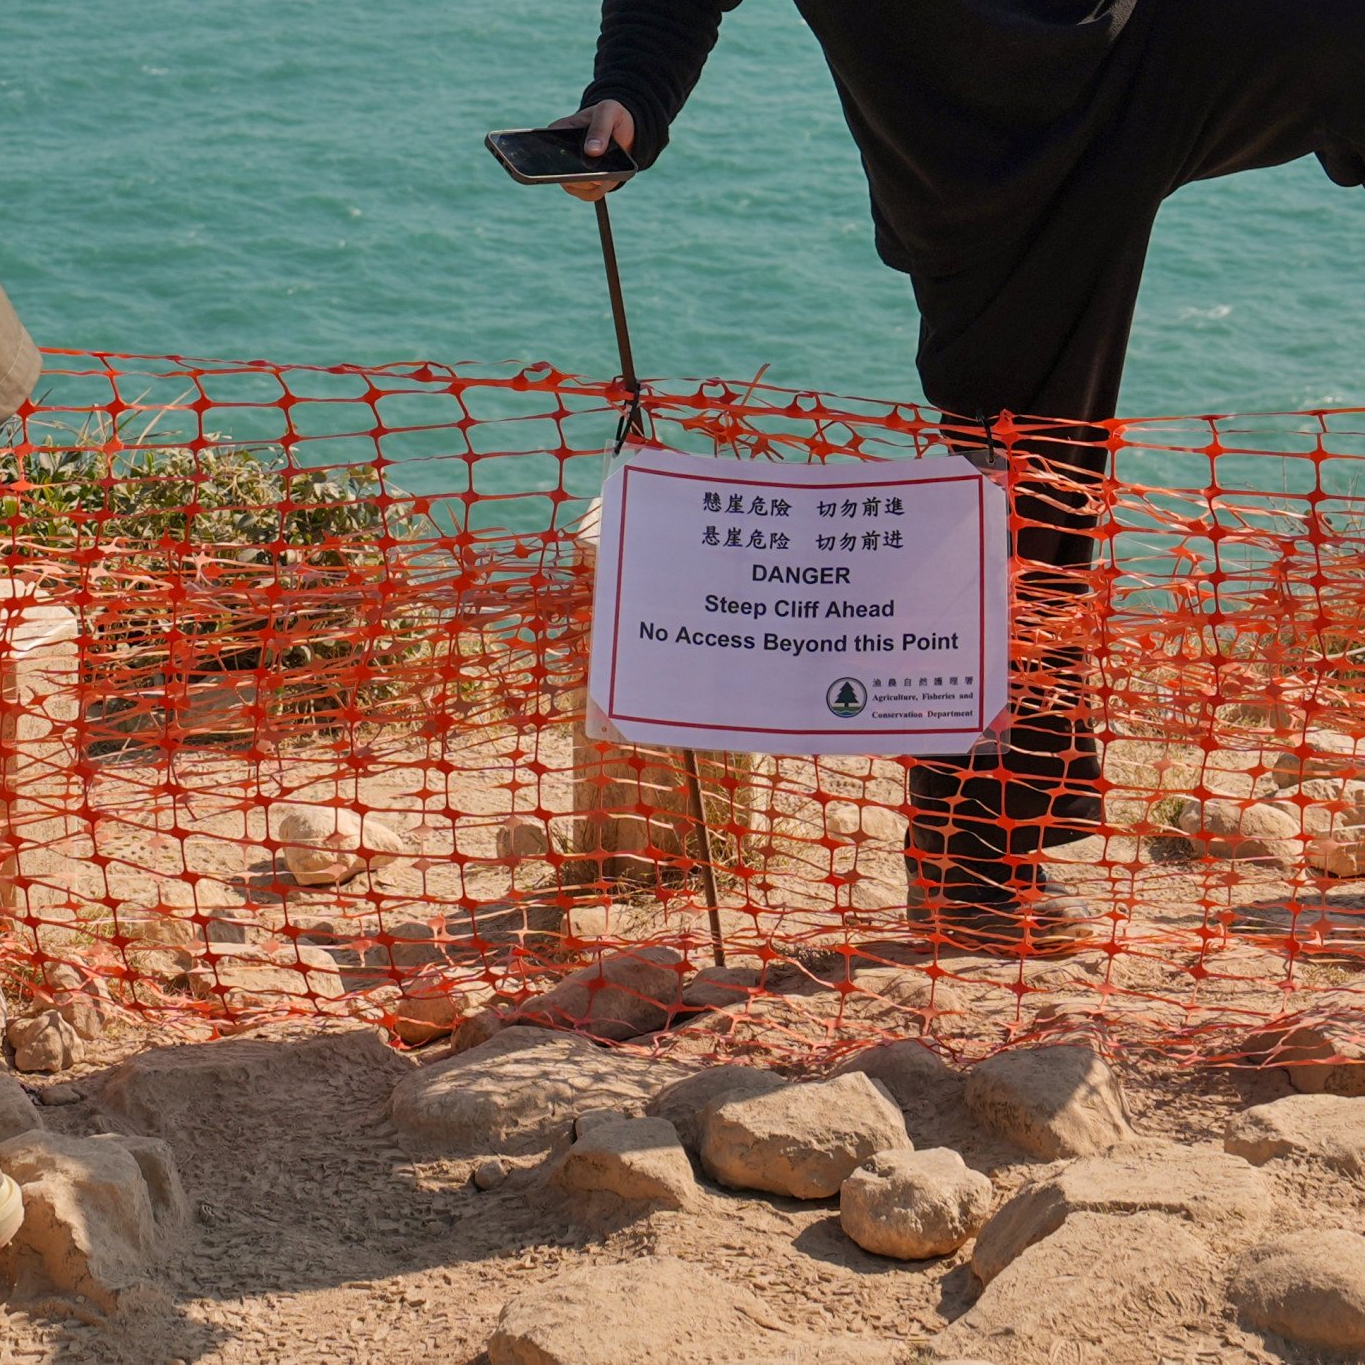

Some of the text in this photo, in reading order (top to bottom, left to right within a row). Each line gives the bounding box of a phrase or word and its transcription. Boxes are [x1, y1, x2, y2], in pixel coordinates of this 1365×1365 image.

[703, 492, 905, 518] 懸崖危險 切勿前進
[702, 525, 904, 552] 悬崖危险 切勿前进
[752, 564, 850, 584] DANGER
[705, 594, 894, 619] Steep Cliff Ahead
[639, 621, 958, 656] No Access Beyond this Point
[872, 693, 918, 702] Agriculture,
[922, 692, 955, 700] Fisheries
[872, 710, 973, 719] Conservation Department
